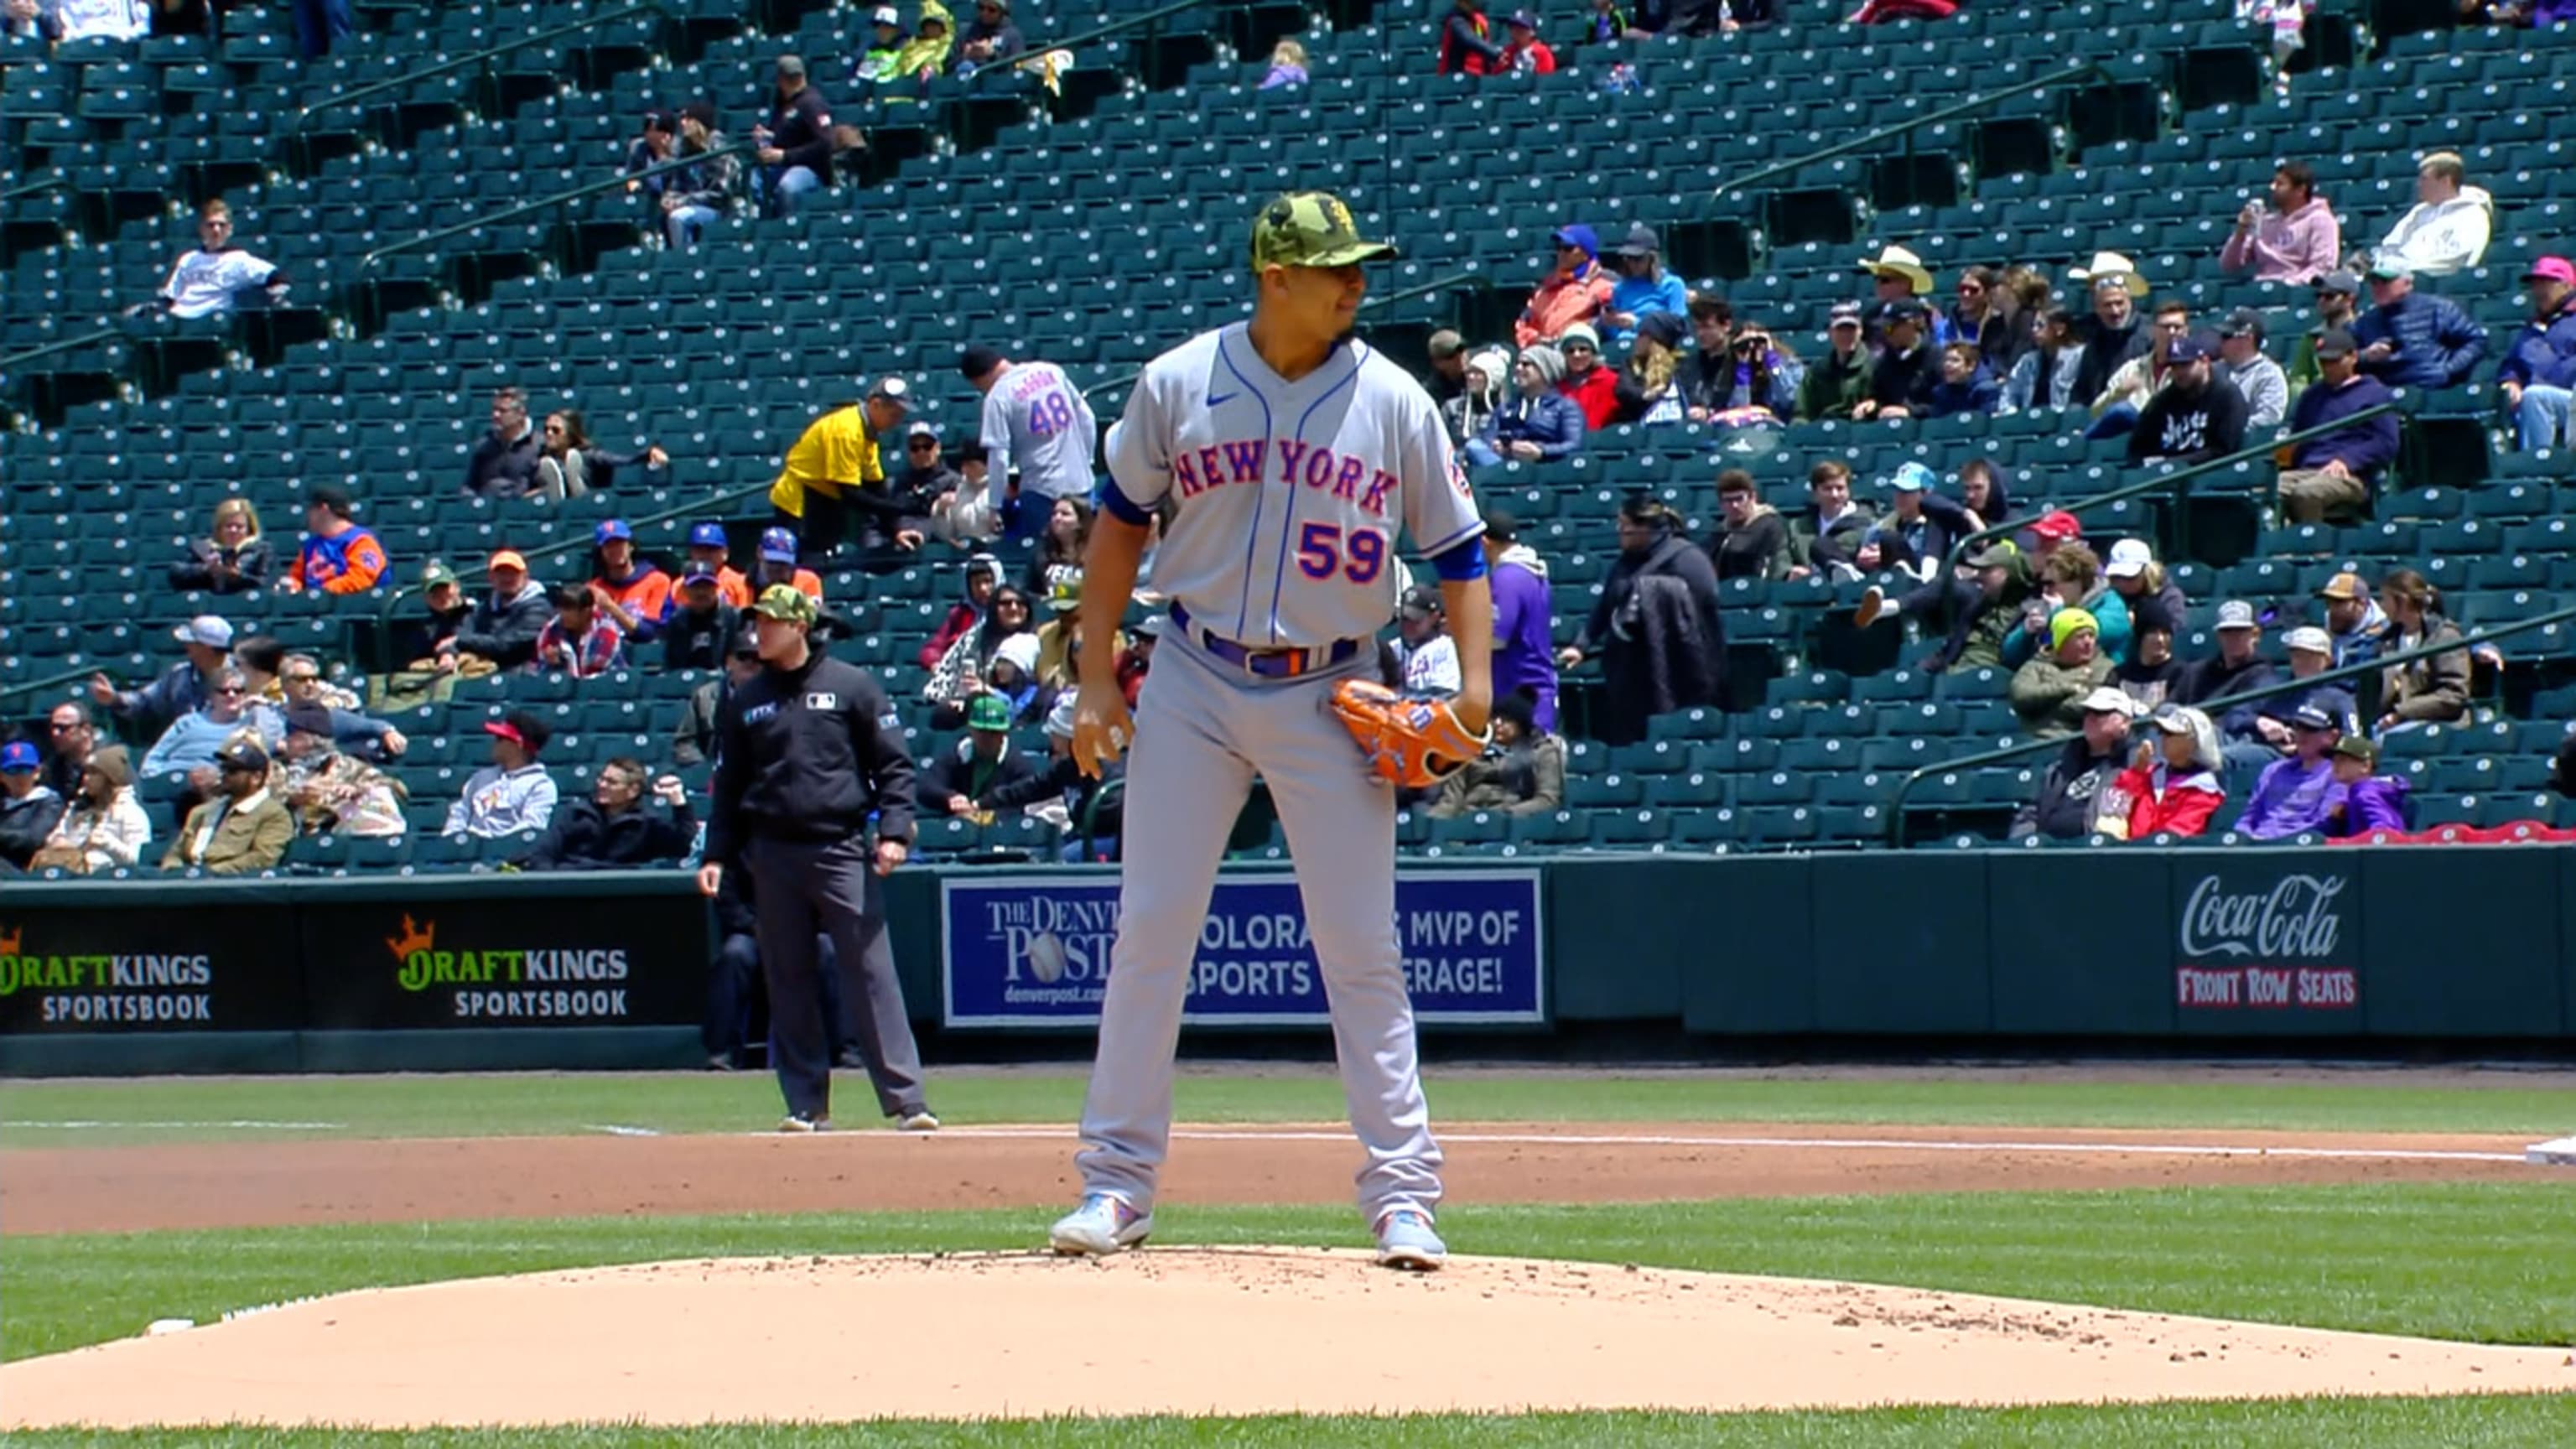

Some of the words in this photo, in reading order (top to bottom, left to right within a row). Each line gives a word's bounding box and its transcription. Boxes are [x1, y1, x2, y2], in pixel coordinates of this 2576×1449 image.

[1030, 390, 1073, 434] 48
[1175, 439, 1268, 499] NEW
[1277, 439, 1399, 517] YORK
[1296, 519, 1387, 585] 59
[986, 901, 1031, 932] THE
[1201, 914, 1313, 949] OLORA
[1410, 911, 1474, 946] MVP
[1479, 910, 1520, 946] OF
[2181, 875, 2346, 957] Coca-Cola
[0, 954, 211, 995] DRAFTKINGS
[398, 949, 628, 991] DRAFTKINGS
[1402, 958, 1504, 994] ERAGE!
[2178, 968, 2241, 1004] FRONT
[2246, 968, 2291, 1004] ROW
[2298, 968, 2355, 1004] SEATS
[42, 995, 210, 1021] SPORTSBOOK
[454, 989, 627, 1016] SPORTSBOOK
